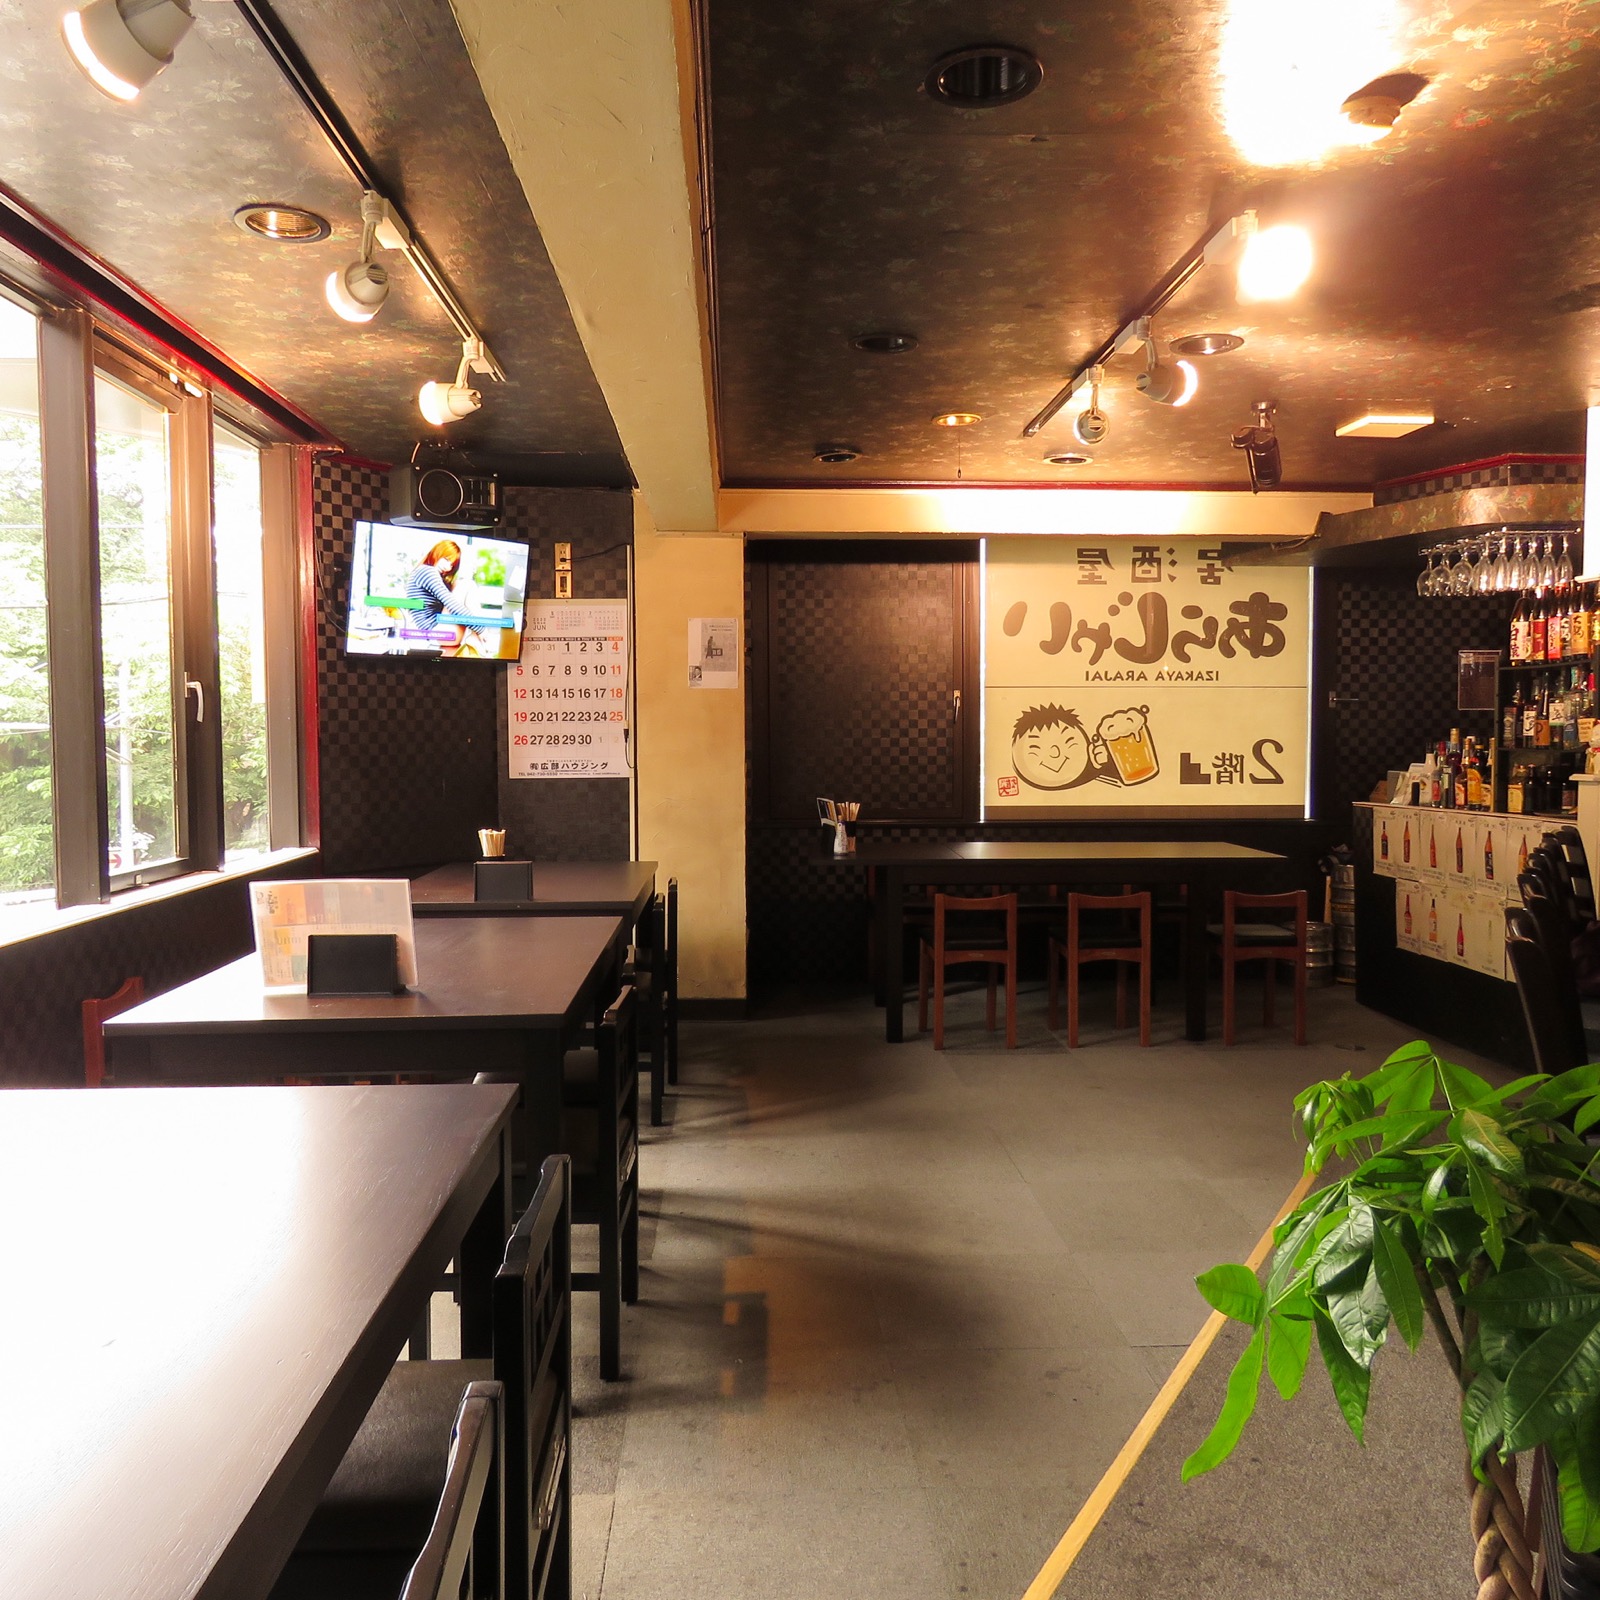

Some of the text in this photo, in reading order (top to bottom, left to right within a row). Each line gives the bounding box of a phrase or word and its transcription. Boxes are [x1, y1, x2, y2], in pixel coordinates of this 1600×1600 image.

[565, 642, 570, 652] 1
[580, 642, 587, 652] 2
[596, 642, 603, 652] 3
[612, 642, 619, 652] 4
[516, 665, 622, 676] 5 6 7 8 9 10 11
[513, 688, 623, 699] 12 13 14 15 16 17 18
[514, 711, 624, 722] 19 20 21 22 23 24 25
[513, 734, 528, 746] 26
[530, 734, 544, 746] 27
[545, 734, 560, 746] 28
[561, 734, 576, 746] 29
[577, 734, 592, 746] 30
